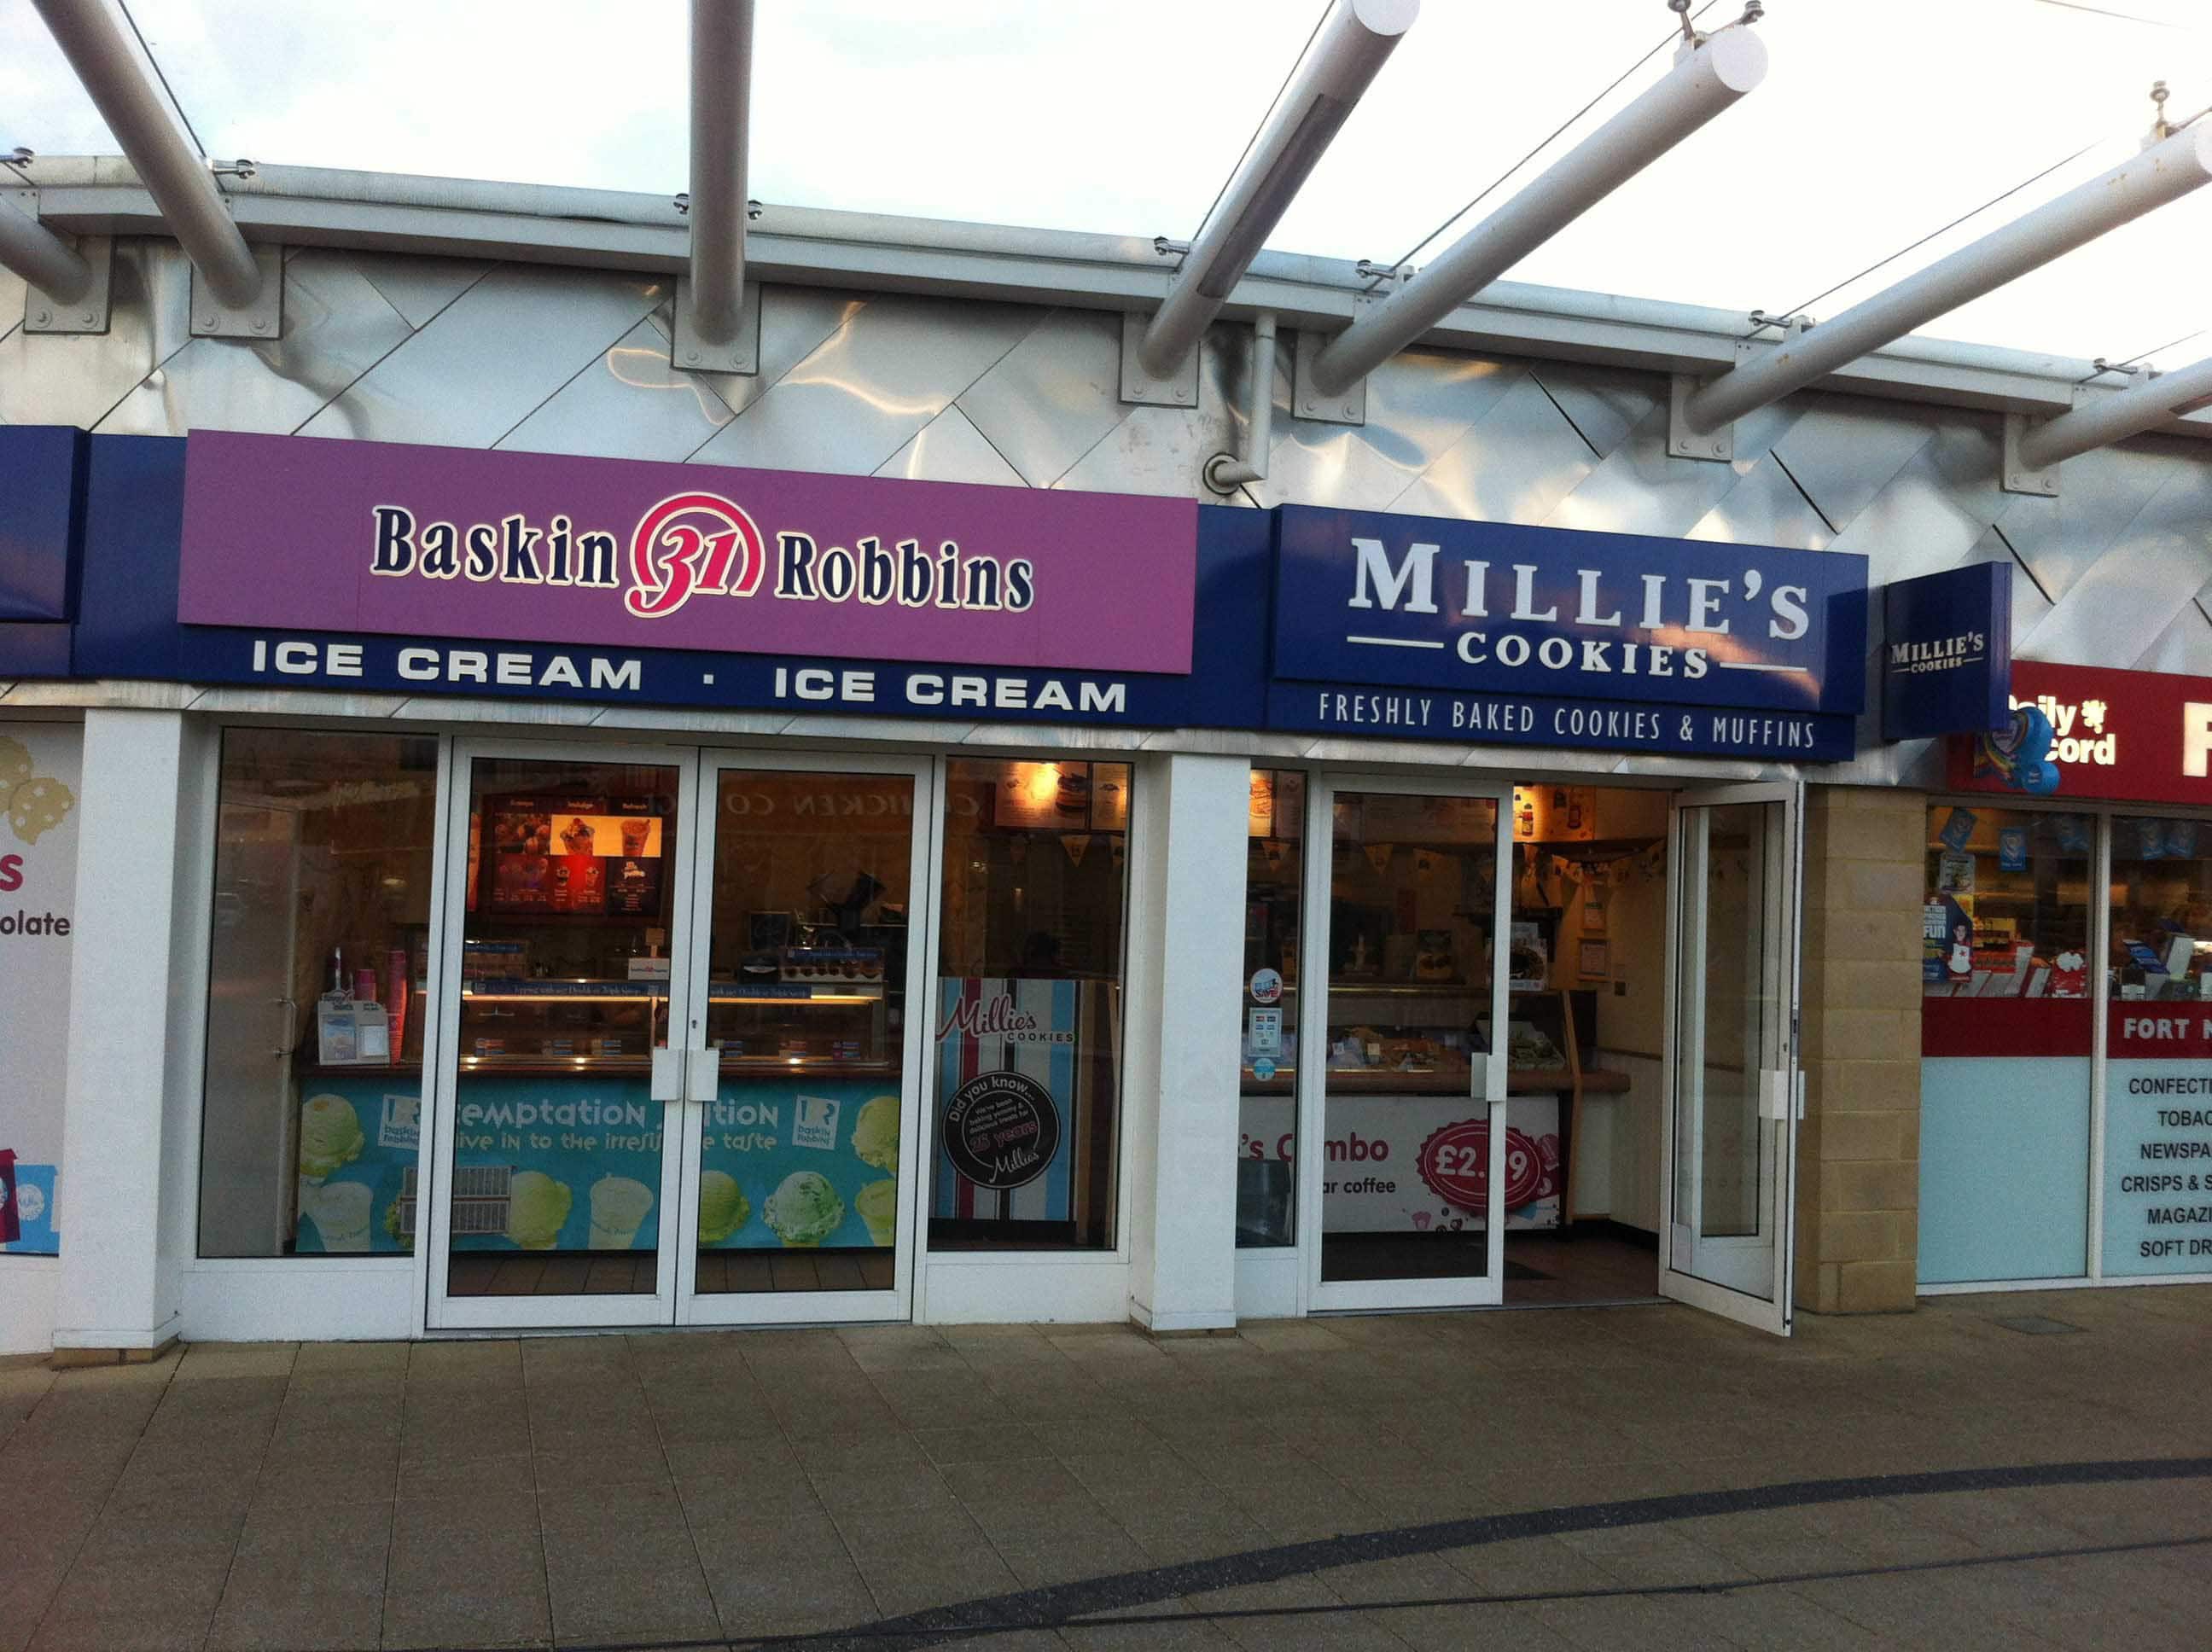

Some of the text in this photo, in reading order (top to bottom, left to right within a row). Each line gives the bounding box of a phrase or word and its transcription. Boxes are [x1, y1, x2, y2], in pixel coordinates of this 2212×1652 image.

[370, 505, 619, 587] Baskin
[774, 531, 1033, 613] Robbins
[1348, 538, 1809, 640] MILLIE'S
[1457, 632, 1708, 679] COOKIES
[1891, 631, 1984, 664] MILLIE'S
[253, 640, 1126, 713] ICE CREAM ICE CREAM
[1911, 657, 1962, 673] COOKIES
[1319, 693, 1814, 748] FRESHLY BAKED COOKIES & MUFFINS
[935, 995, 1038, 1039] Millie's
[2123, 1018, 2191, 1039] FORT
[1007, 1032, 1074, 1042] COOKIES
[457, 1098, 647, 1129] emptation
[949, 1097, 967, 1122] Did
[964, 1080, 988, 1103] you
[531, 1131, 553, 1149] to
[1435, 1145, 1528, 1180] £2.9
[1343, 1178, 1395, 1194] coffee
[2122, 1176, 2183, 1193] CRISPS
[2188, 1175, 2199, 1190] &
[2140, 1240, 2185, 1257] SOFT
